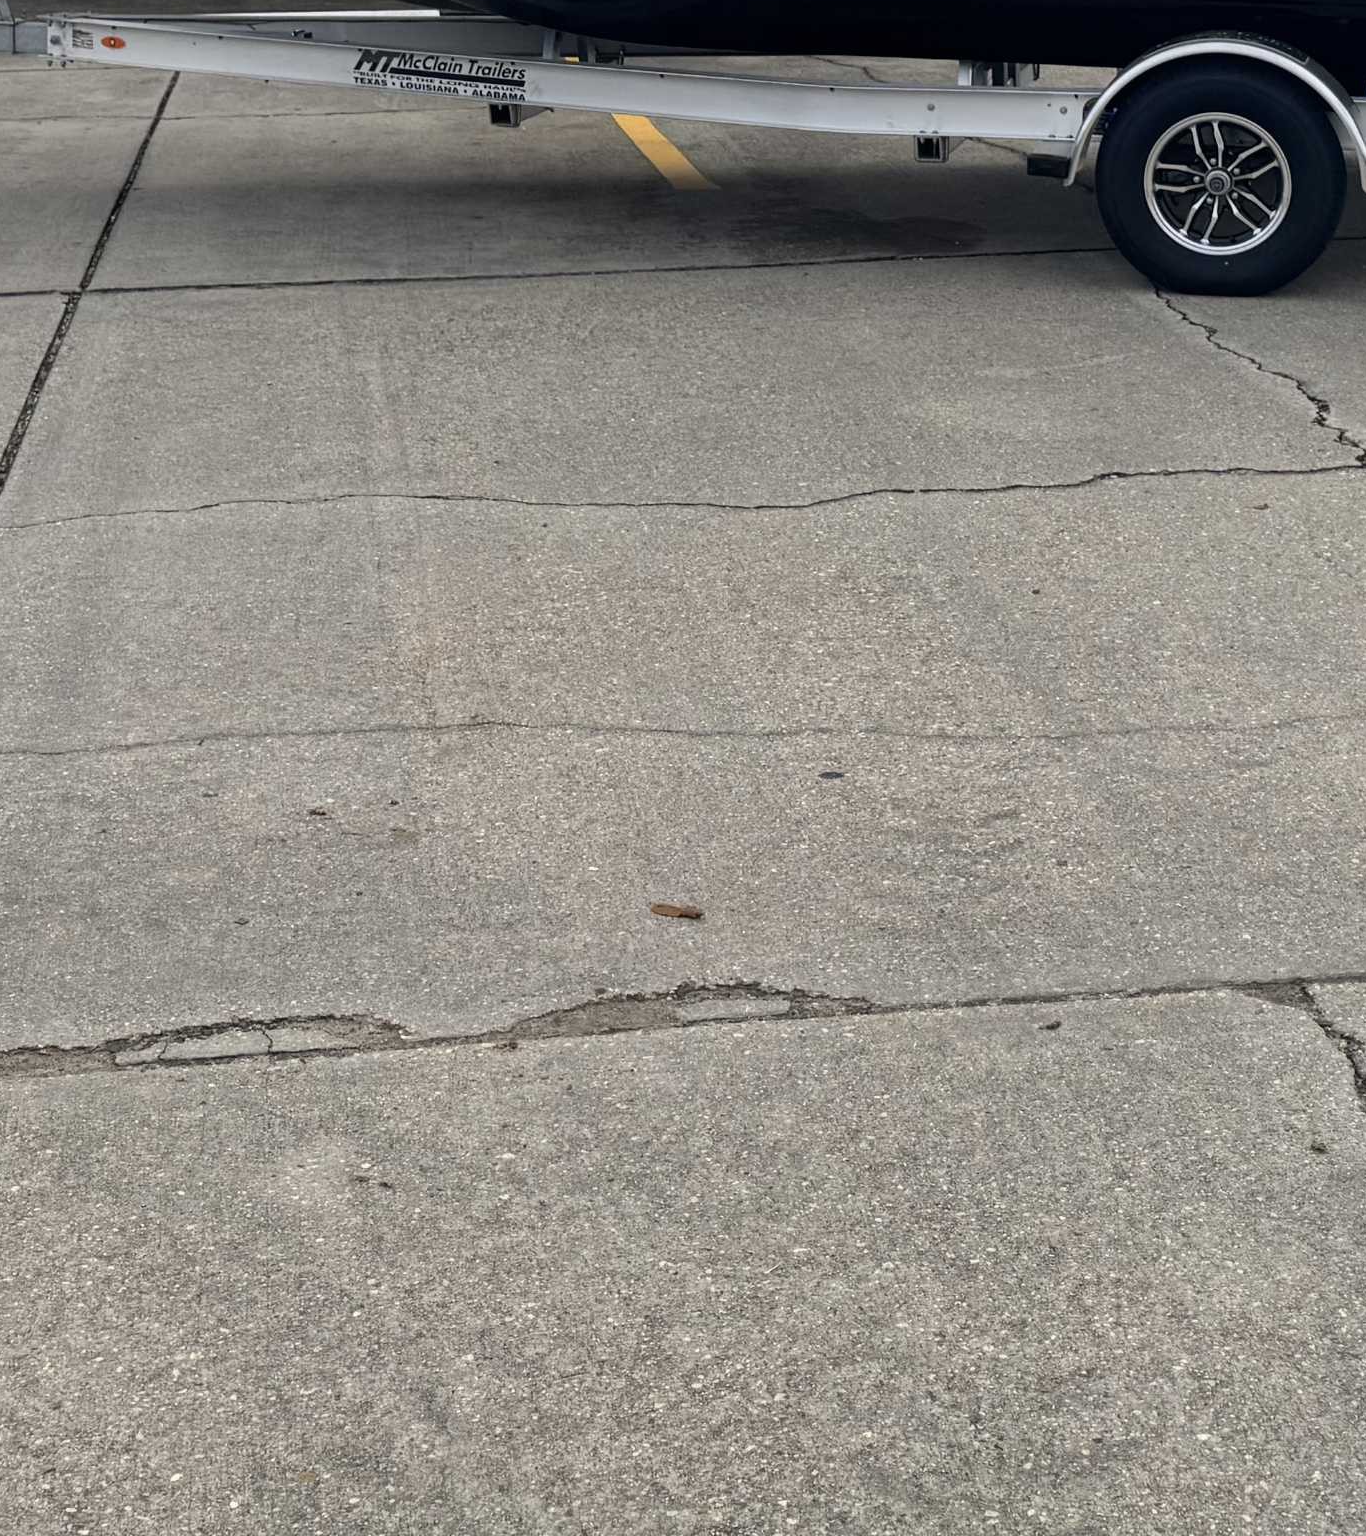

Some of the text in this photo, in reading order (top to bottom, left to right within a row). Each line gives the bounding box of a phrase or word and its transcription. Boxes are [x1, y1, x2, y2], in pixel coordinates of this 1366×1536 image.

[354, 49, 526, 80] MT McClain Trailers
[354, 77, 526, 102] TEXAS LOUISIANA ALABAMA
